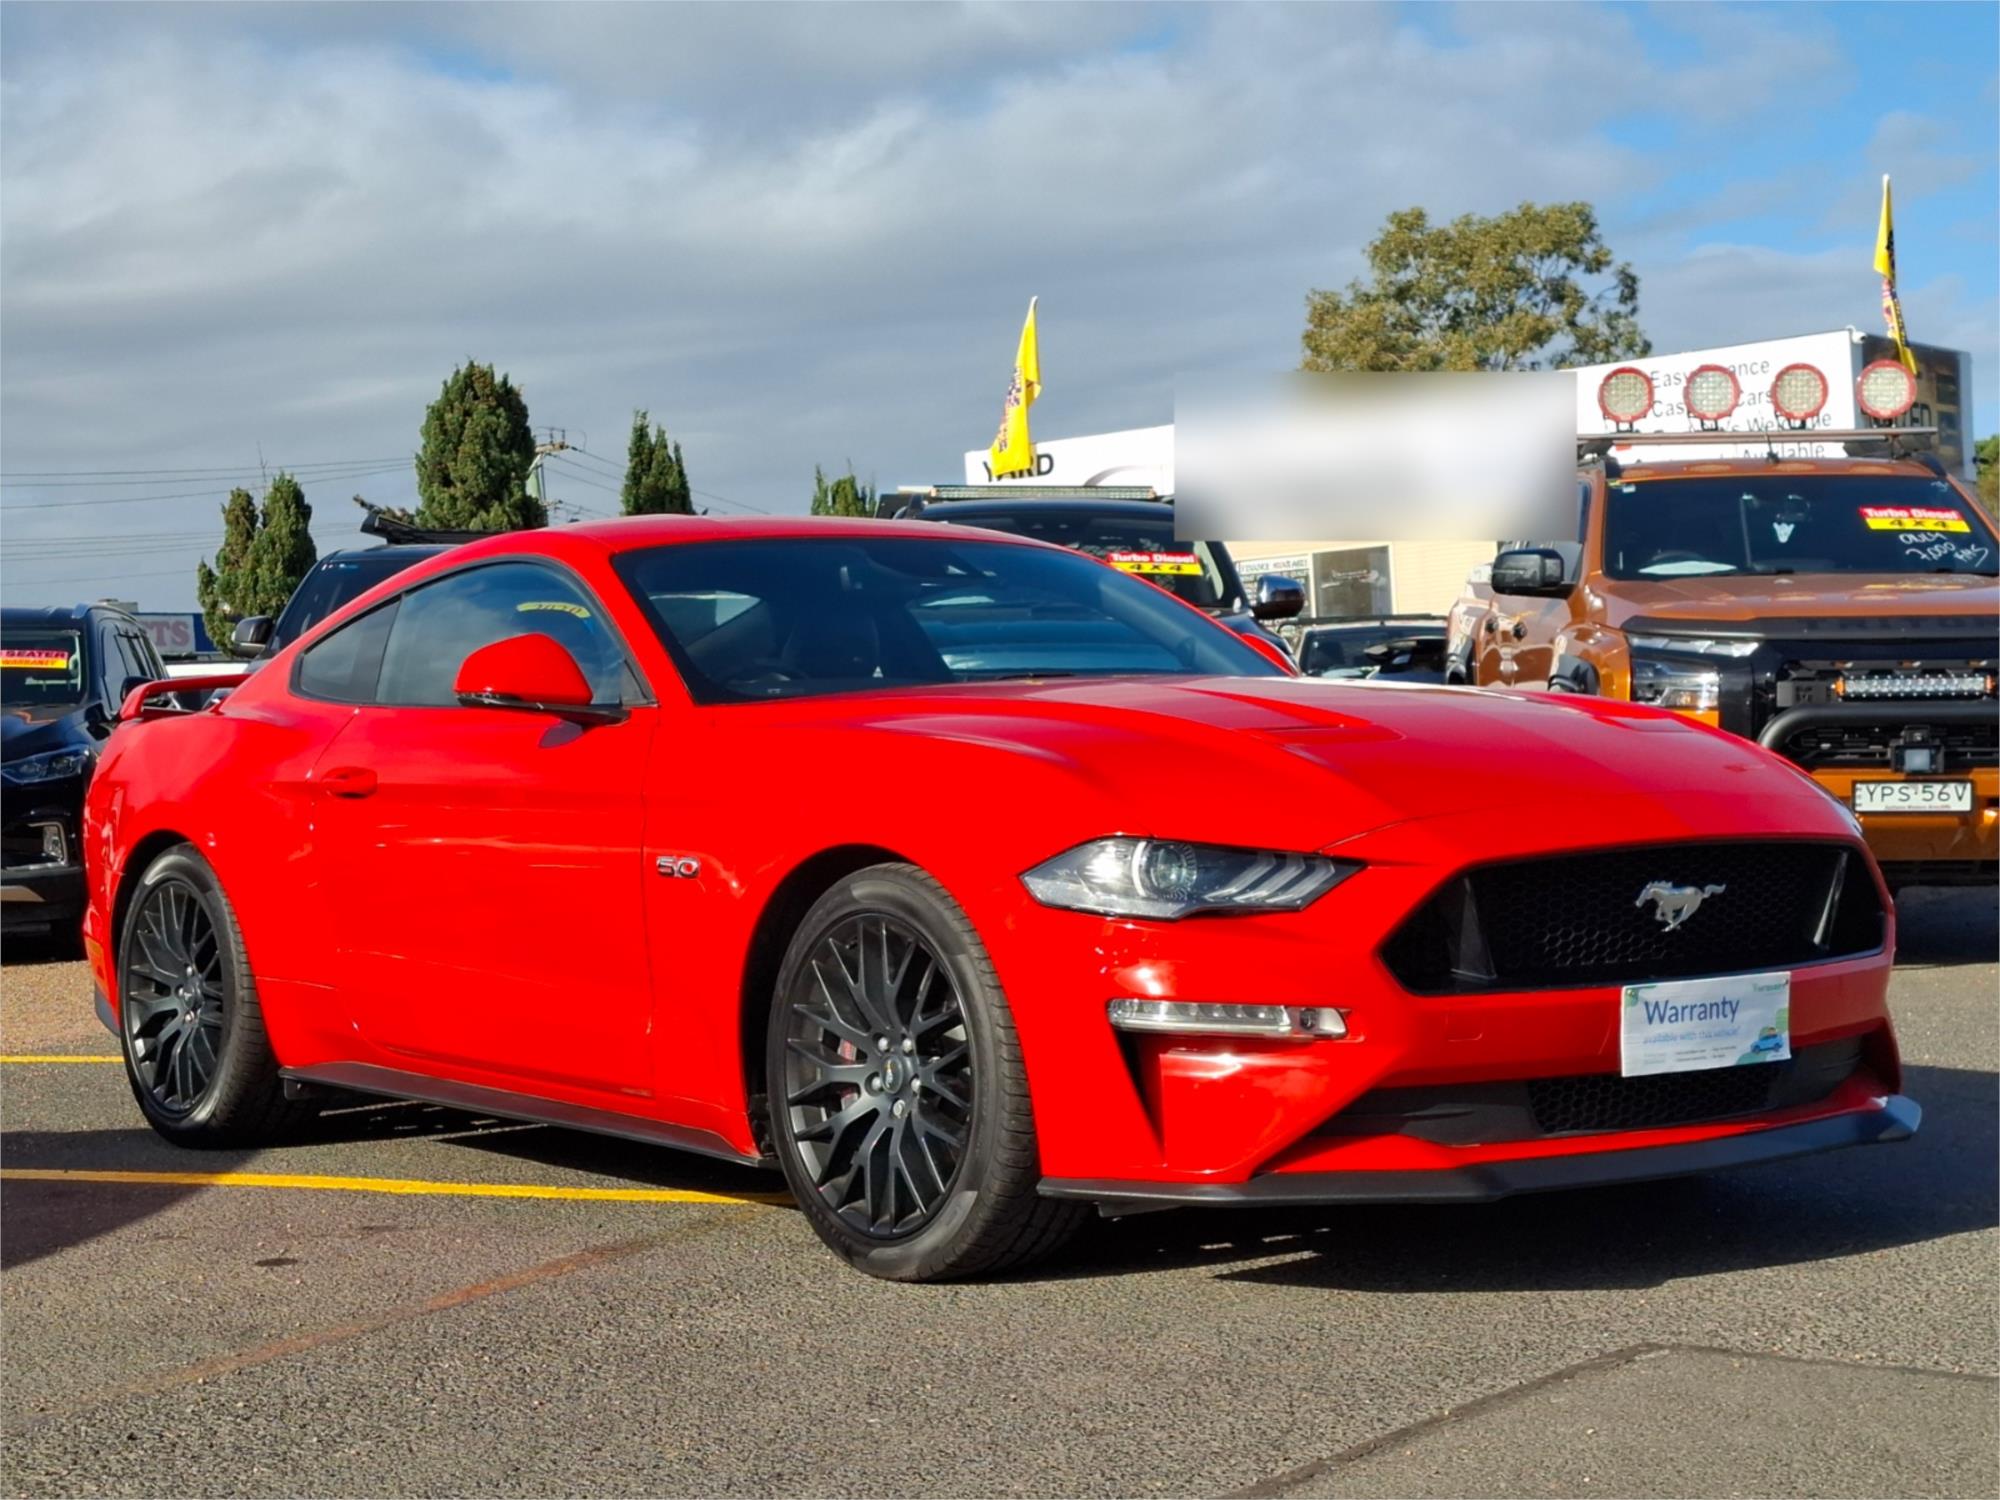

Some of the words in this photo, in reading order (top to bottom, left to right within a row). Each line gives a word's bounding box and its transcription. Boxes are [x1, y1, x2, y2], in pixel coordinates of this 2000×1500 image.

[1743, 443, 1825, 460] Ailable
[1910, 508, 1960, 520] Diesel
[1152, 552, 1196, 563] Diesel
[145, 621, 190, 647] TS
[1644, 996, 1740, 1026] Warranty
